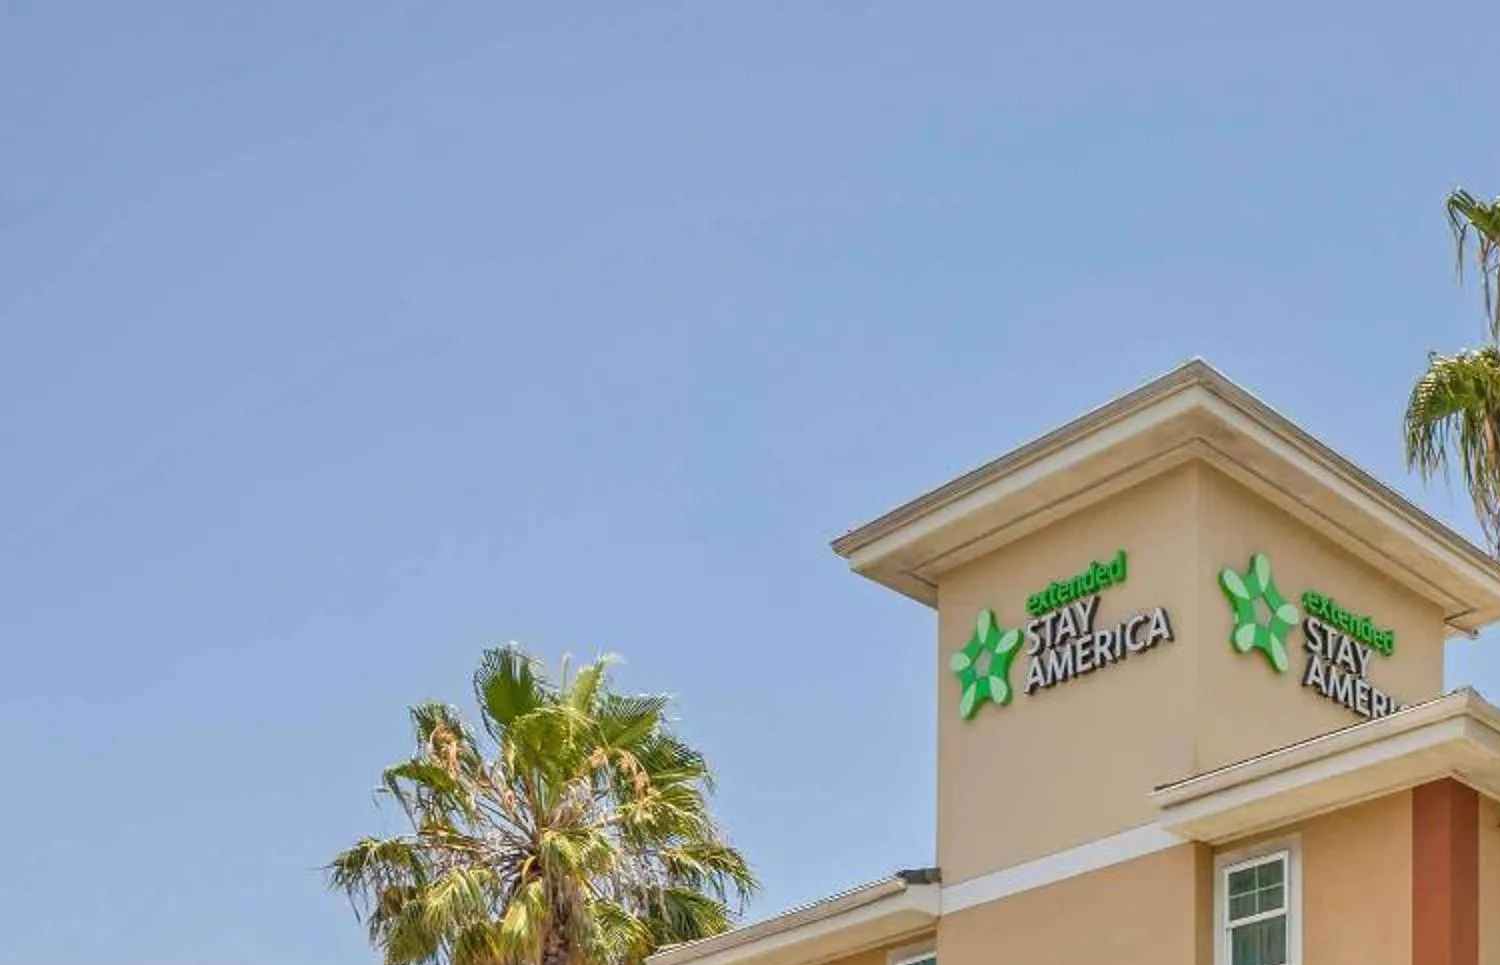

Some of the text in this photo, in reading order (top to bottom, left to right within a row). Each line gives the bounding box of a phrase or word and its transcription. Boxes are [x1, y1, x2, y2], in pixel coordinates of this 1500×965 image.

[1025, 549, 1127, 616] extended
[1024, 606, 1175, 695] AMERICA
[1026, 596, 1101, 656] STAY
[1302, 590, 1395, 656] extended
[1303, 616, 1371, 677] STAY
[1302, 655, 1409, 720] AMERI
